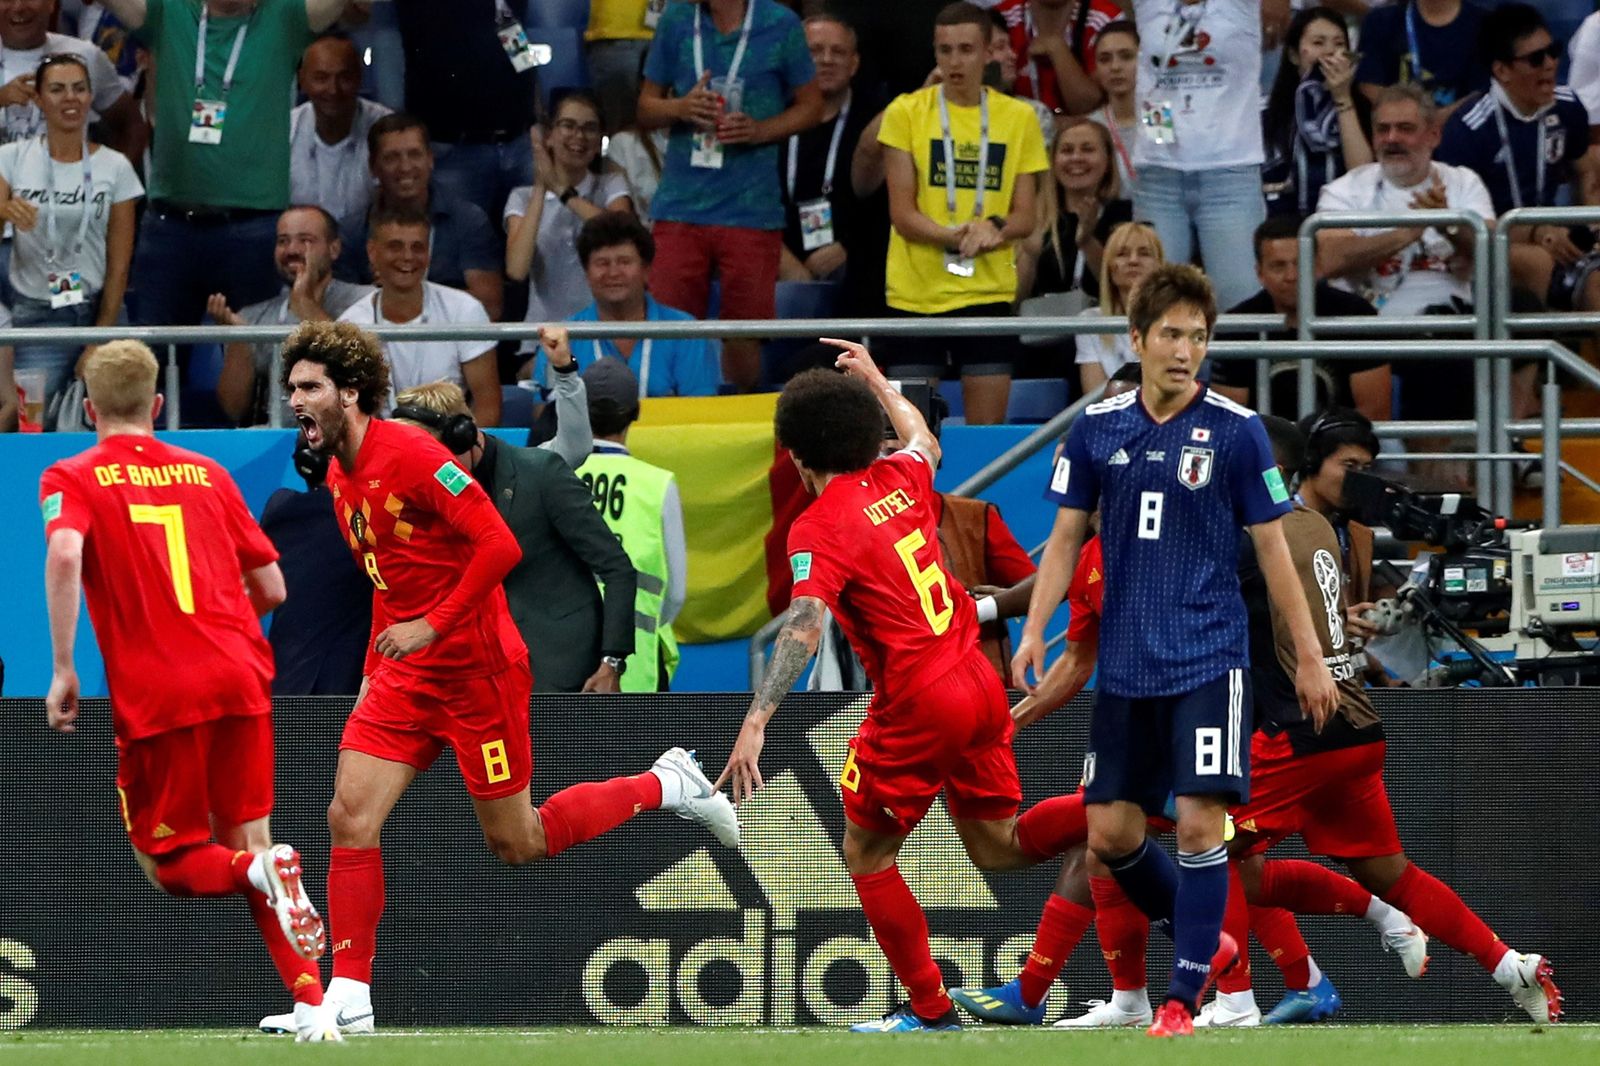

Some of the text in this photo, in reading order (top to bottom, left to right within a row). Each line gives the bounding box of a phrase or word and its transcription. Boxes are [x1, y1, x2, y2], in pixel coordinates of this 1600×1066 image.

[94, 463, 212, 487] DE BRUYNE
[1137, 491, 1164, 540] 8
[128, 503, 195, 615] 7
[363, 552, 388, 590] 8
[893, 527, 954, 637] 6
[481, 739, 512, 785] 8
[1195, 727, 1222, 776] 8
[1177, 958, 1211, 974] JAPAN
